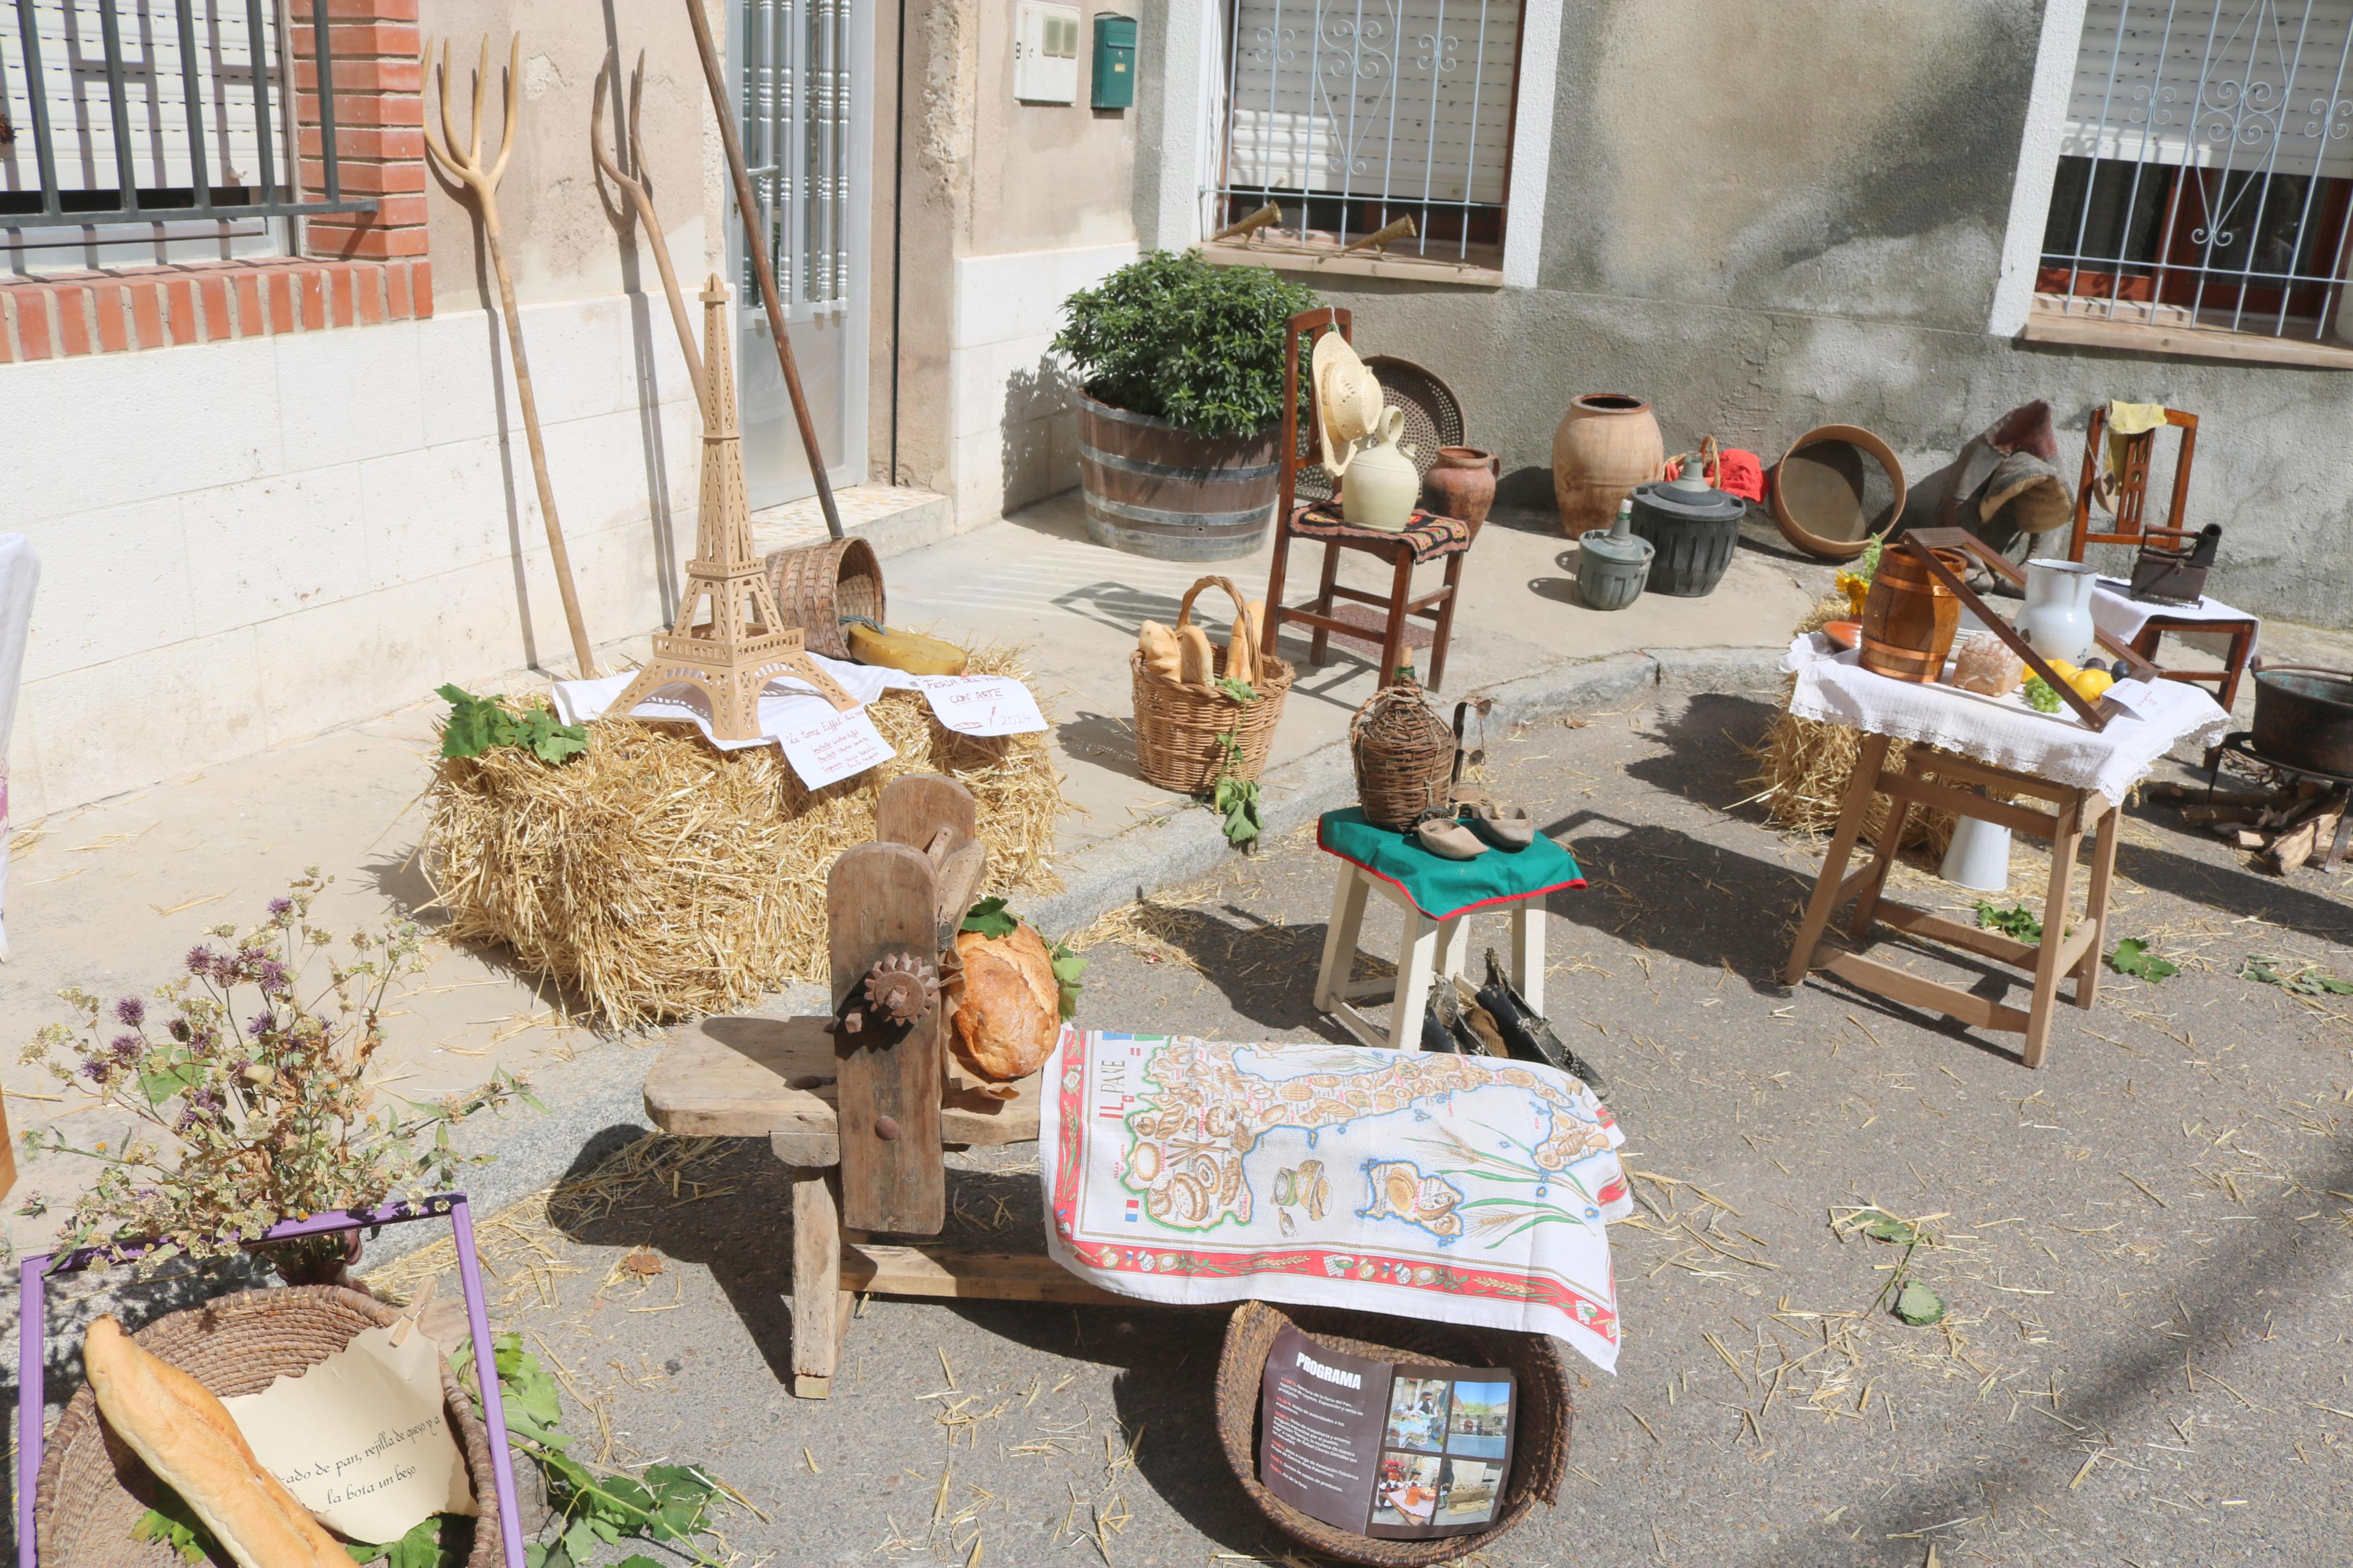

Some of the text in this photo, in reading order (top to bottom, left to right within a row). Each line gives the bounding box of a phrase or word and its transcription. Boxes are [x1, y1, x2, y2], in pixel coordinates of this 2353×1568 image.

[975, 688, 1003, 699] ARTE
[1000, 712, 1031, 726] 2024
[1099, 1060, 1124, 1119] IL PANE
[1412, 1181, 1422, 1214] SARDEGNA
[1296, 1352, 1361, 1390] PROGRAMA
[1278, 1387, 1299, 1399] productos.
[1279, 1381, 1297, 1392] Apertura
[1303, 1393, 1318, 1402] casetas.
[1318, 1399, 1341, 1410] Exposición
[1297, 1384, 1313, 1395] Apertura
[1276, 1402, 1299, 1416] expositores.
[1292, 1403, 1303, 1412] Visita
[1309, 1412, 1334, 1424] autoridades
[1273, 1420, 1293, 1434] Exposición
[1314, 1441, 1332, 1450] muñeca
[1338, 1449, 1355, 1457] nuestra
[1274, 1416, 1290, 1427] antiguos
[1290, 1424, 1309, 1437] expuestos
[1322, 1438, 1339, 1446] pueblo.
[1290, 1418, 1301, 1427] Visita
[1307, 1427, 1330, 1439] maquinaria
[1334, 1437, 1351, 1445] enseres
[314, 1460, 331, 1475] de
[336, 1453, 363, 1477] pan,
[365, 1430, 395, 1460] rejilla
[392, 1427, 405, 1443] de
[406, 1422, 427, 1444] queso
[425, 1420, 438, 1437] y
[434, 1416, 441, 1425] a
[1285, 1432, 1296, 1441] cargo
[1302, 1440, 1315, 1449] Rafael
[1315, 1446, 1330, 1455] Citores
[1330, 1451, 1350, 1461] González
[1284, 1462, 1297, 1473] Sorteo
[1302, 1473, 1314, 1481] cestas
[1321, 1481, 1343, 1492] productos.
[1285, 1448, 1295, 1456] Jotas
[1315, 1463, 1338, 1474] Asociación
[1339, 1470, 1359, 1480] Folclórica
[1287, 1454, 1301, 1464] Danzas
[1312, 1466, 1335, 1478] Palentinos.
[326, 1464, 417, 1505] la bota un beso
[1298, 1481, 1308, 1489] feria.
